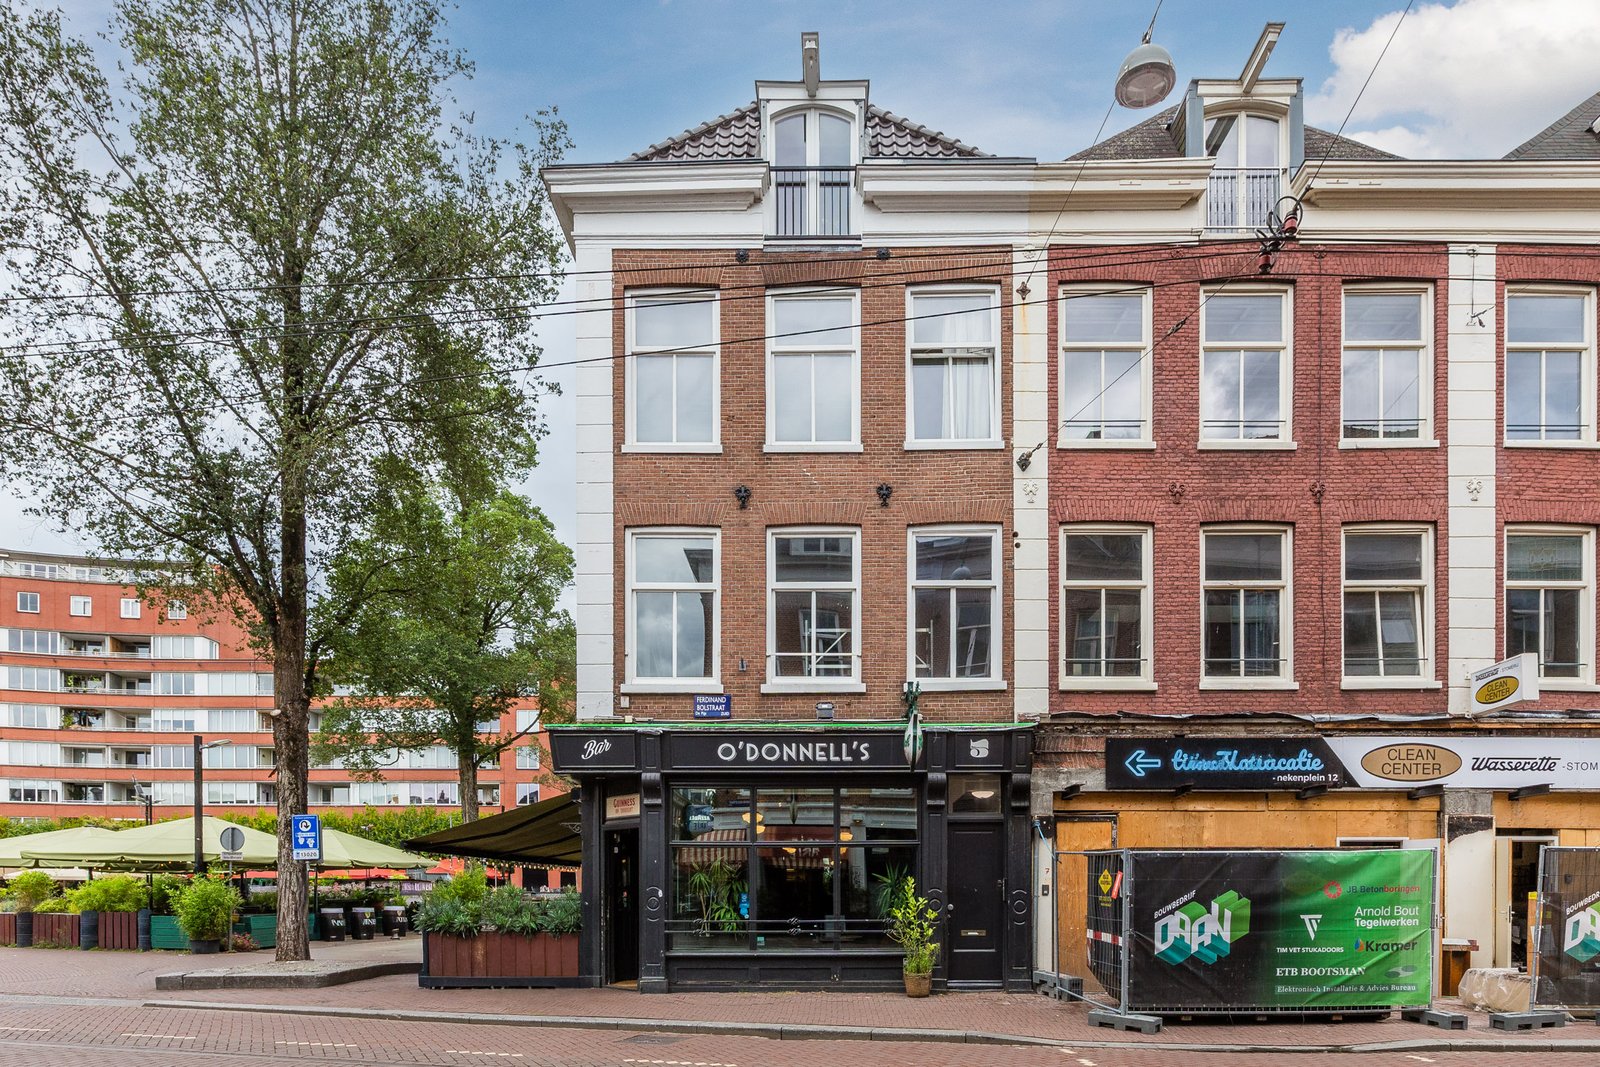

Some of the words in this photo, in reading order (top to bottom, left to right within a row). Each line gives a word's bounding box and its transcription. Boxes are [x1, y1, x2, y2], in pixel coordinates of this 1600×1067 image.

[1486, 680, 1508, 693] CLEAN
[1484, 687, 1511, 702] CENTER
[581, 739, 612, 760] Bar
[717, 741, 870, 762] O'DONNELL'S
[970, 738, 989, 758] 5
[1387, 748, 1436, 761] CLEAN
[1381, 762, 1442, 775] CENTER
[1471, 756, 1561, 772] Wasserette
[1327, 774, 1339, 782] 12
[1347, 885, 1358, 894] JB
[1360, 885, 1420, 895] Betonboringen
[1154, 889, 1197, 919] BOUWBEDRIJF
[1354, 905, 1391, 916] Arnold
[1393, 905, 1419, 916] Bout
[1154, 896, 1240, 960] DAAN
[1354, 917, 1419, 929] Tegelwerken
[1365, 940, 1418, 952] Kramer
[1275, 967, 1299, 977] ETB
[1300, 967, 1366, 977] BOOTSMAN
[1277, 985, 1321, 993] Elektronisch
[1366, 984, 1389, 992] Advies
